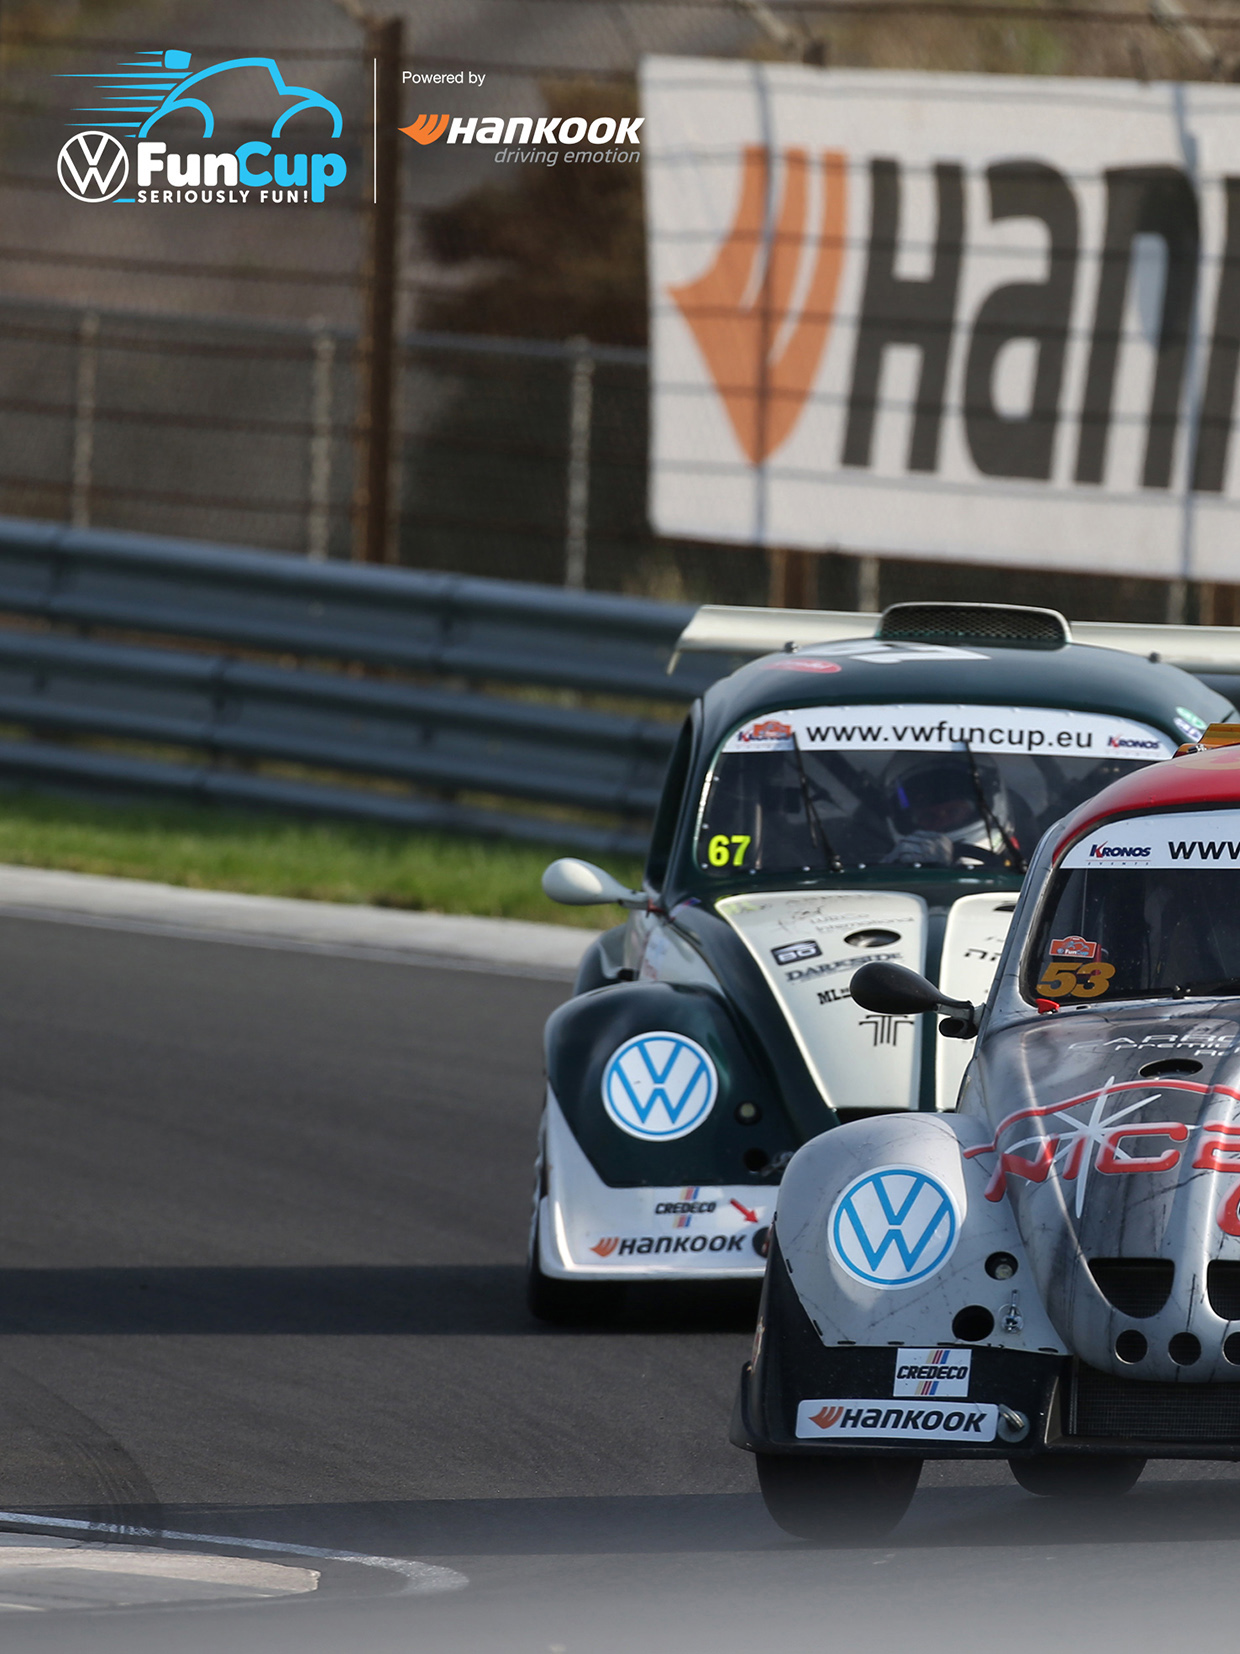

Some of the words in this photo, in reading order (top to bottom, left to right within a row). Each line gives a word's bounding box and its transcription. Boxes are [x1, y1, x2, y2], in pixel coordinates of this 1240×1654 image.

[806, 719, 1093, 751] www.vwfuncup.eu
[1107, 733, 1161, 749] KRONOS
[708, 834, 751, 867] 67
[1089, 841, 1151, 858] KRONOS
[1036, 962, 1116, 998] 53
[655, 1202, 717, 1214] CREDECO
[897, 1365, 969, 1380] CREDECO
